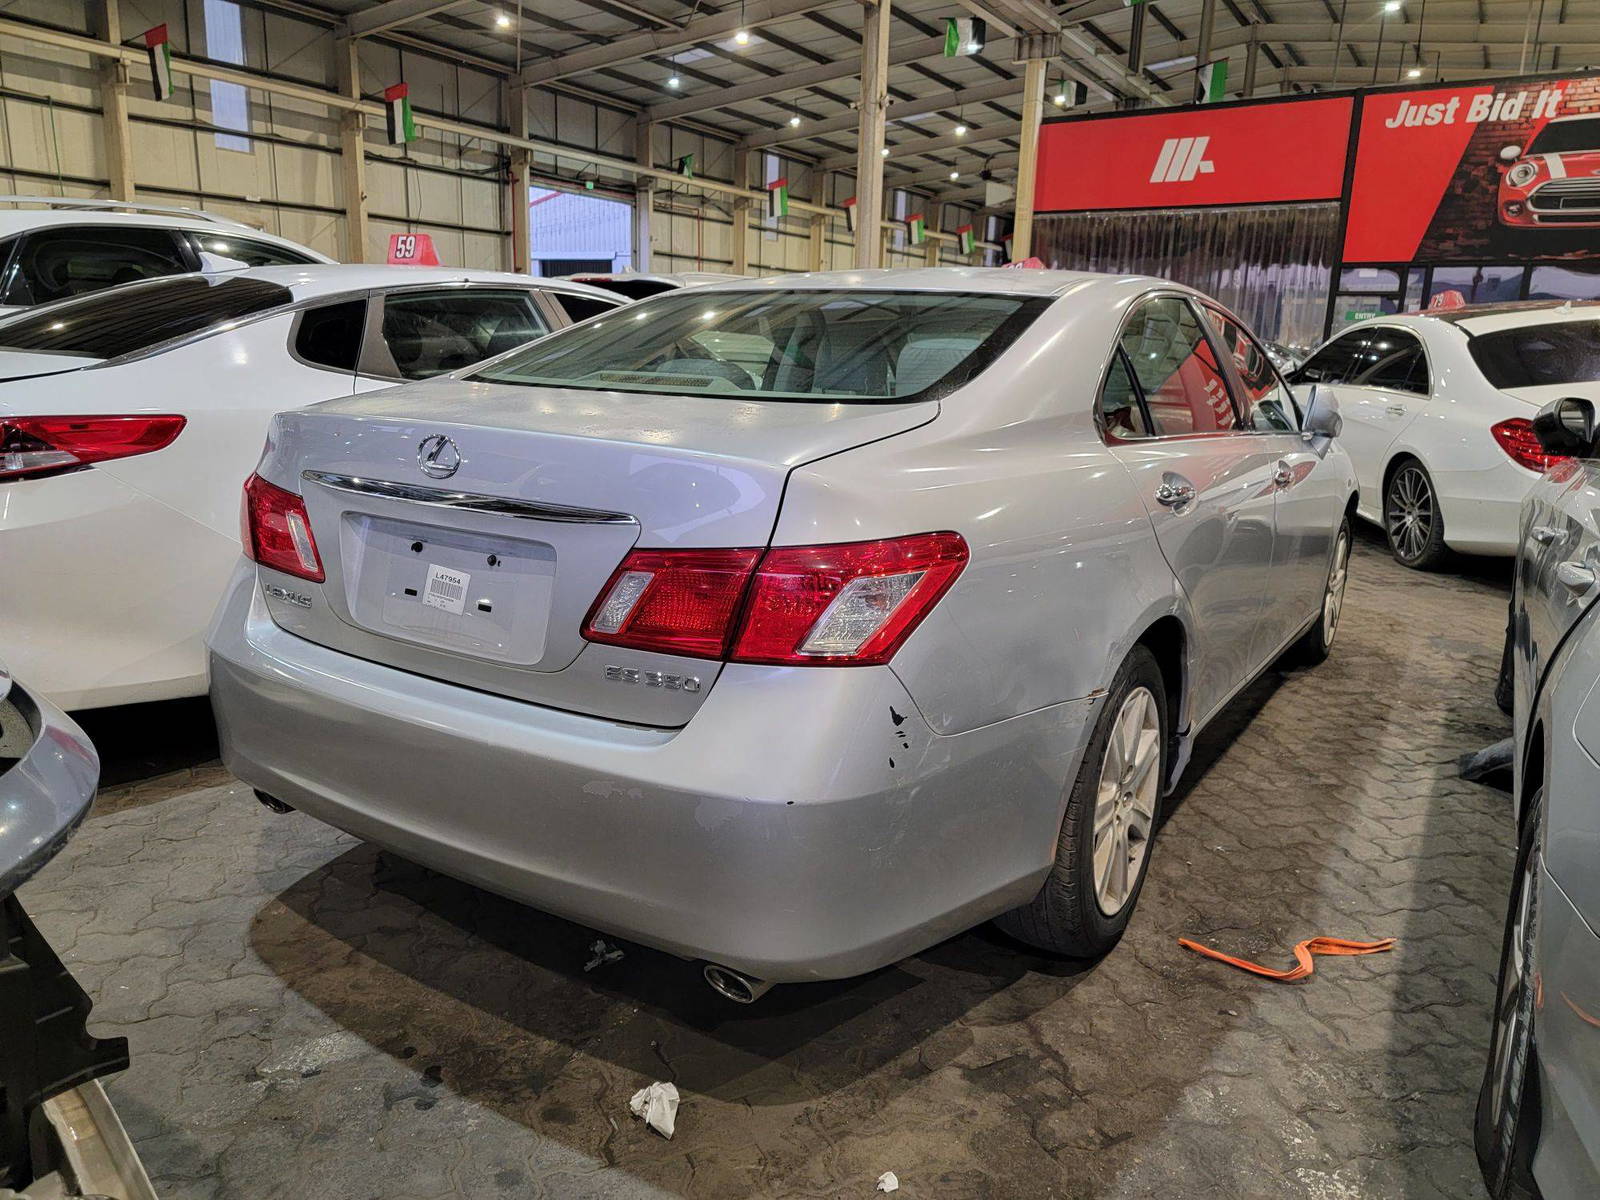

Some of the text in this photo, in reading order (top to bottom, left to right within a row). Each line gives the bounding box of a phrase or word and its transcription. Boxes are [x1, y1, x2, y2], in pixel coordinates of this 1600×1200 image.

[1385, 89, 1563, 128] Just Bid It
[396, 235, 416, 258] 59
[435, 572, 461, 585] L47954
[603, 664, 701, 692] ES 350
